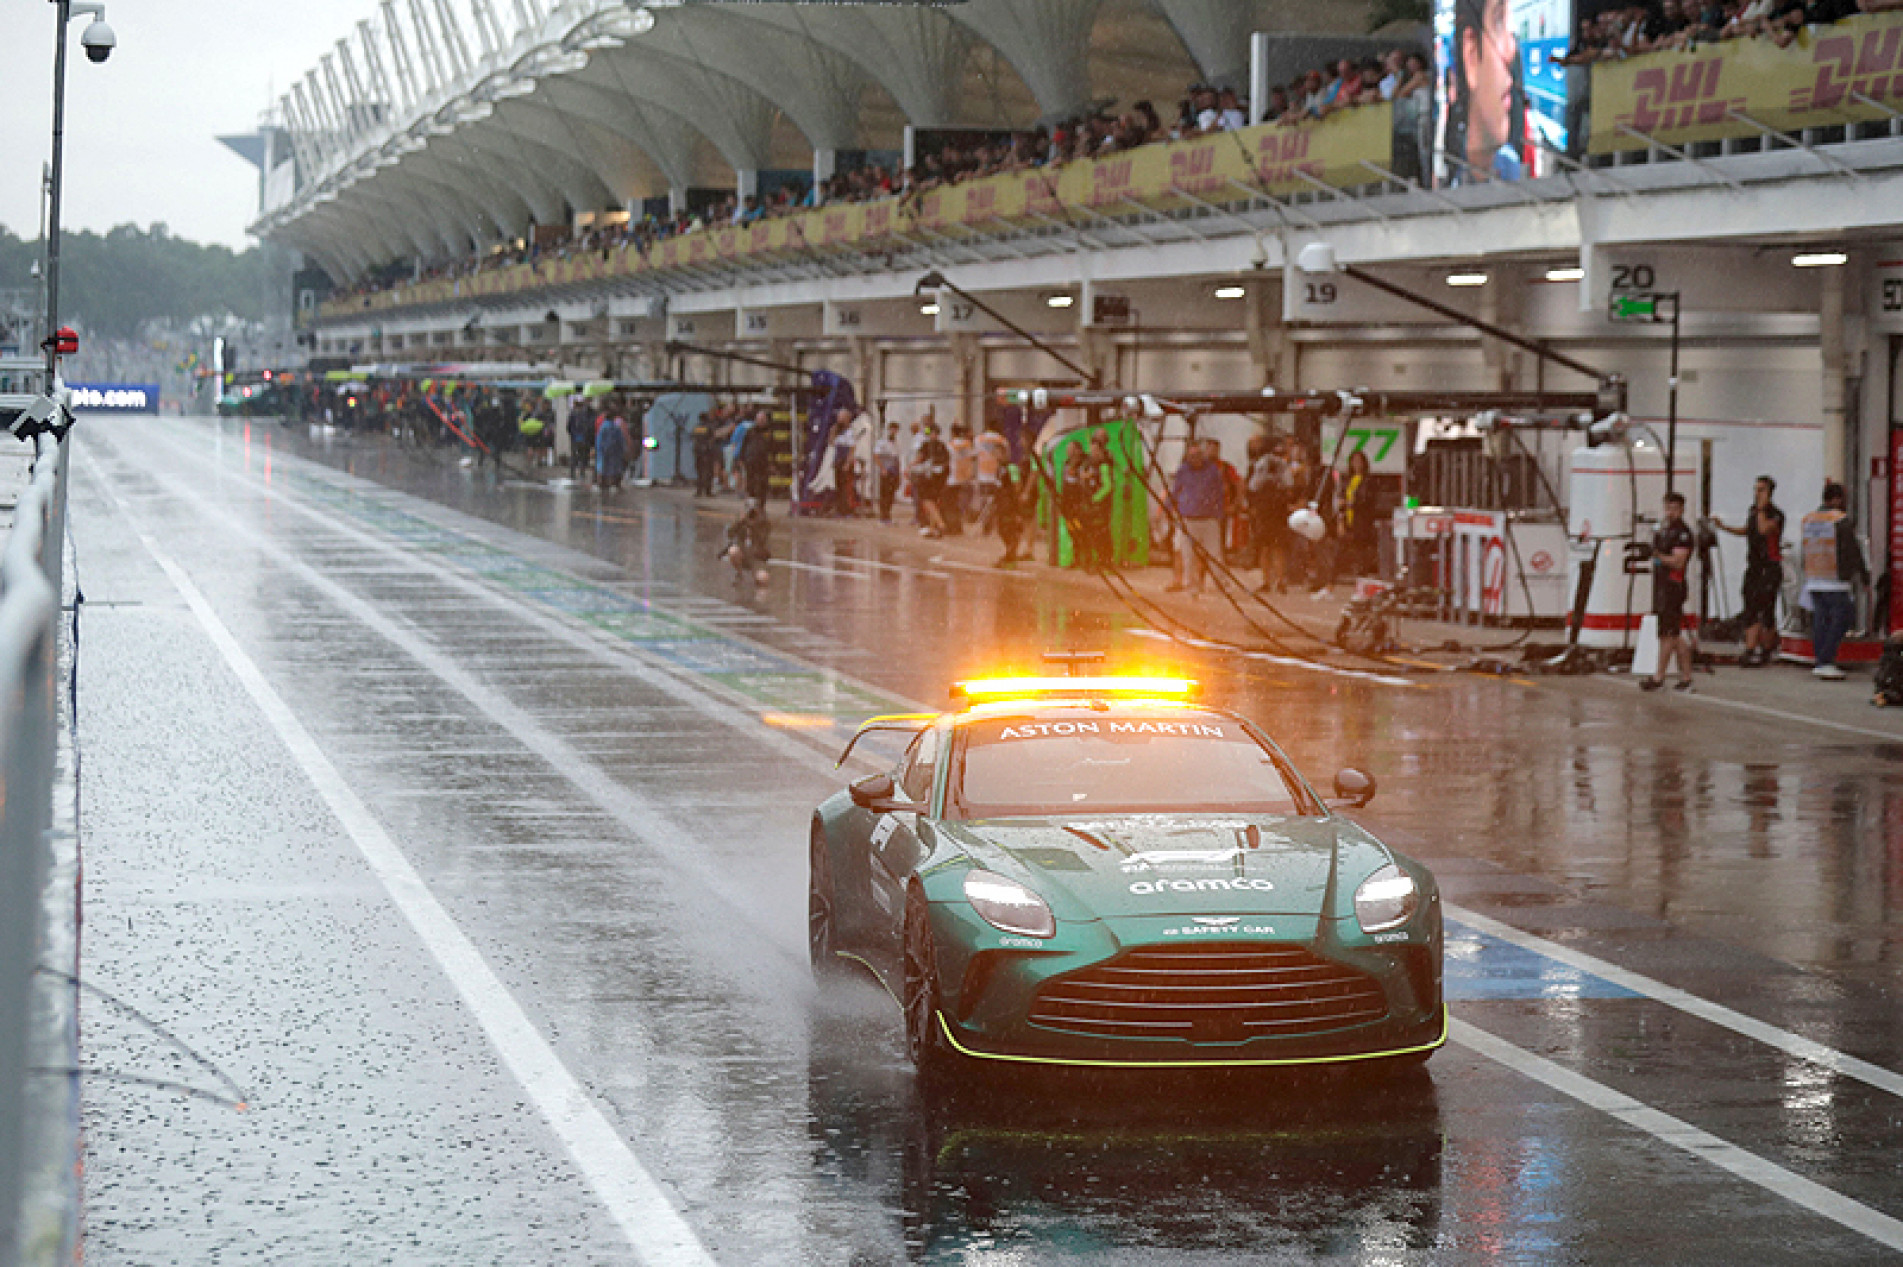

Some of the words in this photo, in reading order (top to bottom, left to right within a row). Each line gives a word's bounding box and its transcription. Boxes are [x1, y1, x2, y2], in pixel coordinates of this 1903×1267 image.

[1811, 26, 1903, 109] DH
[1633, 57, 1728, 132] DHL
[1171, 145, 1216, 193] DHL
[1258, 130, 1314, 184] DHL
[1094, 159, 1133, 205] DHL
[1612, 266, 1654, 288] 20
[1305, 285, 1337, 302] 19
[951, 303, 973, 321] 17
[1345, 428, 1400, 463] 77
[1001, 722, 1100, 740] ASTON
[1110, 722, 1224, 738] MARTIN
[1129, 877, 1274, 895] aramco
[1181, 926, 1238, 935] SAFETY
[1243, 925, 1276, 935] CAR
